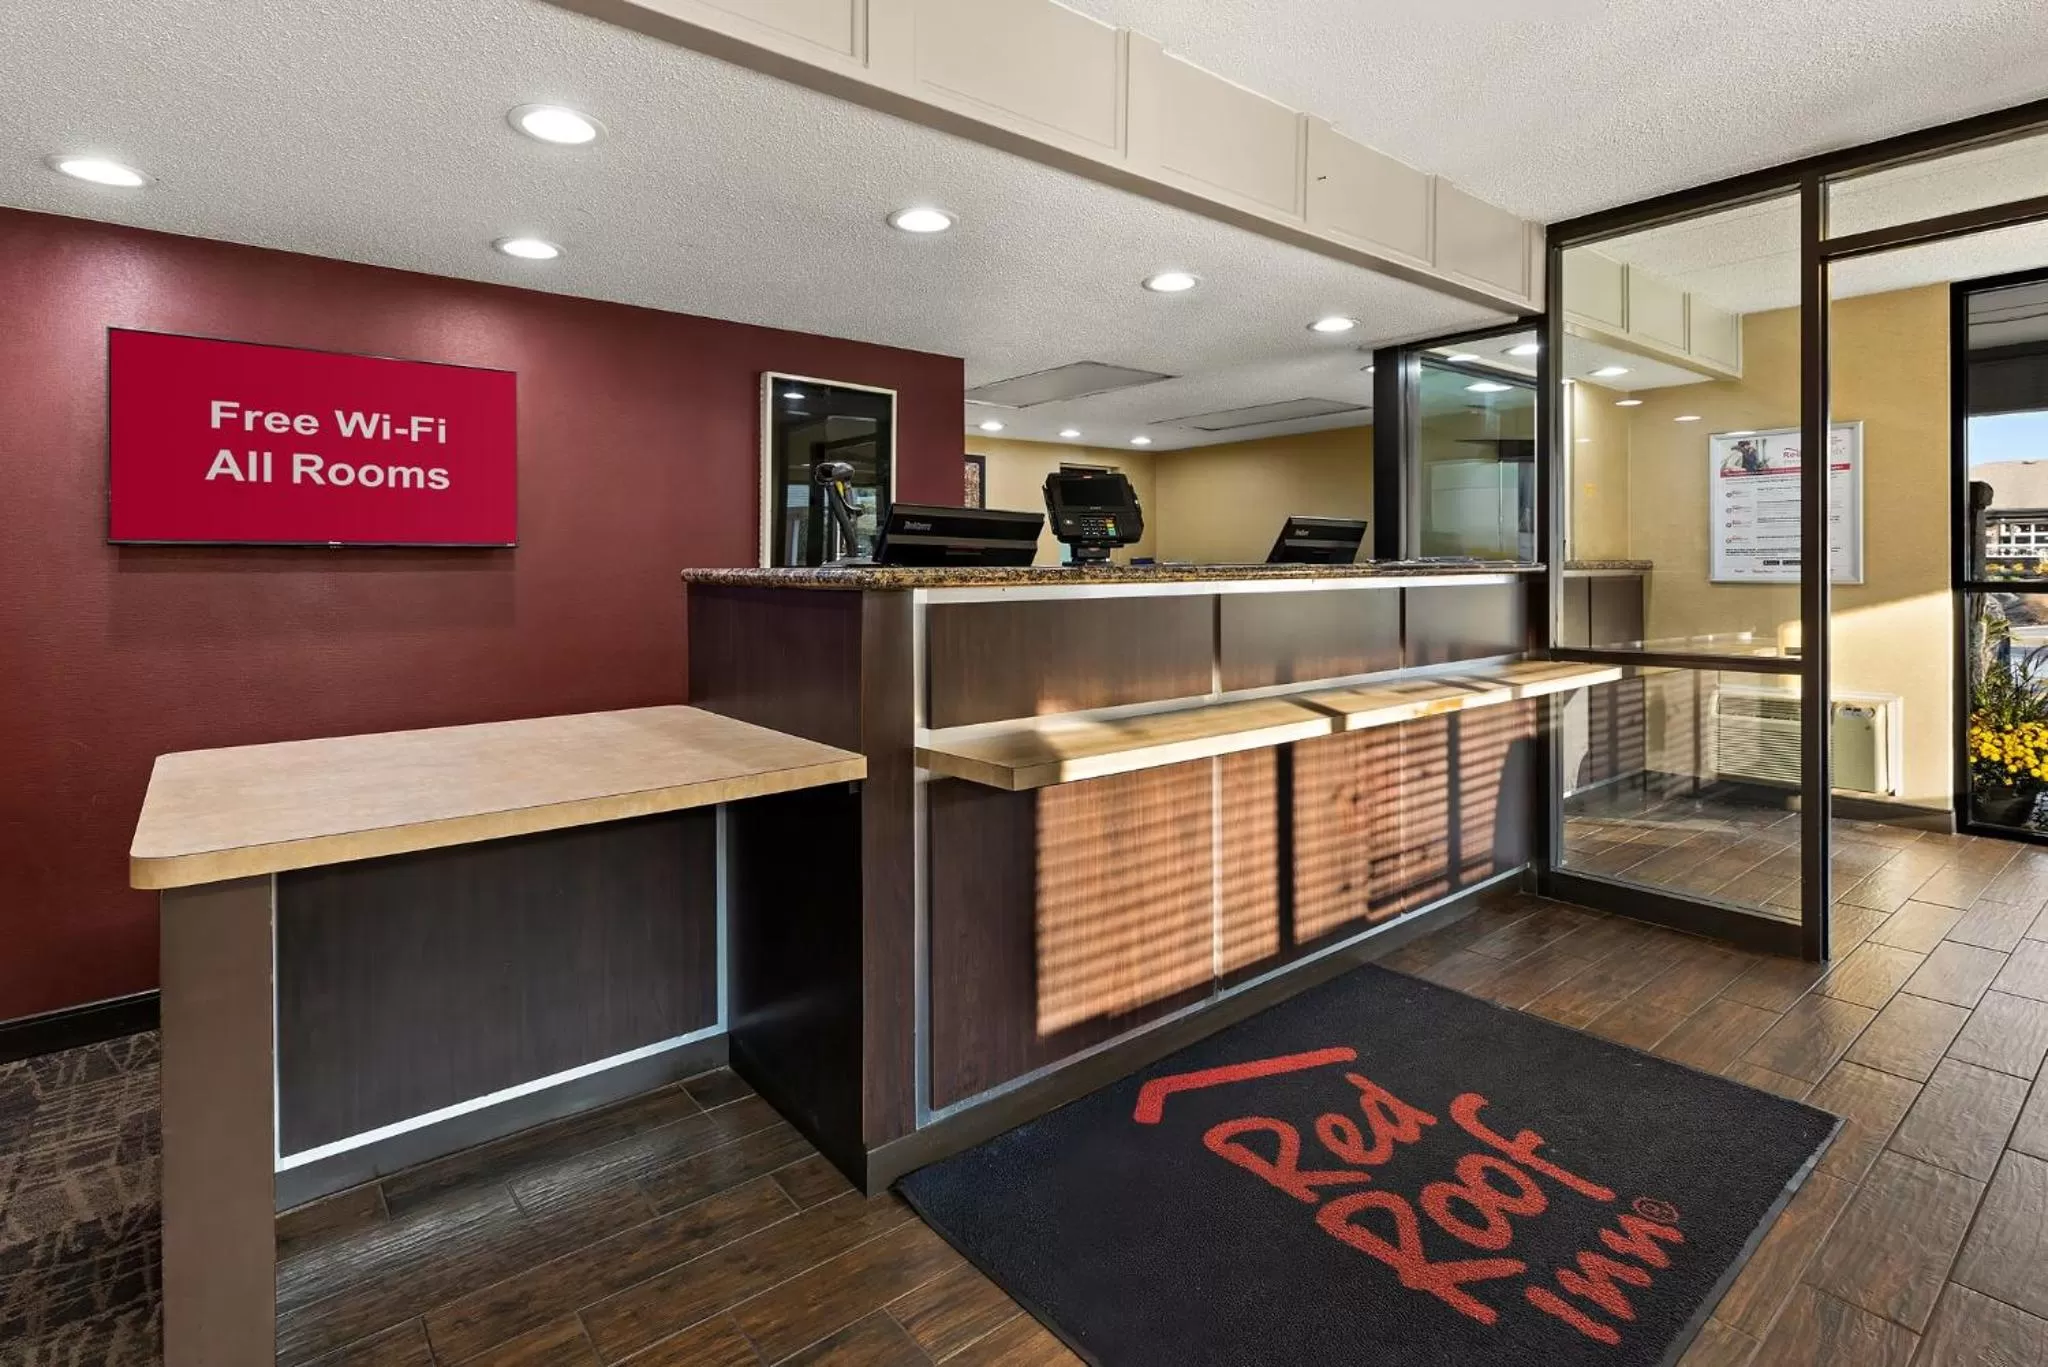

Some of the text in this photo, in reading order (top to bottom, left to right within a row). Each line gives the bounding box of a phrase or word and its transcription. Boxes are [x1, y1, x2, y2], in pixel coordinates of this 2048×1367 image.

[210, 400, 447, 444] Free Wi-Fi
[205, 449, 450, 490] All Rooms
[1203, 1073, 1438, 1203] Red
[1316, 1092, 1616, 1325] Roof
